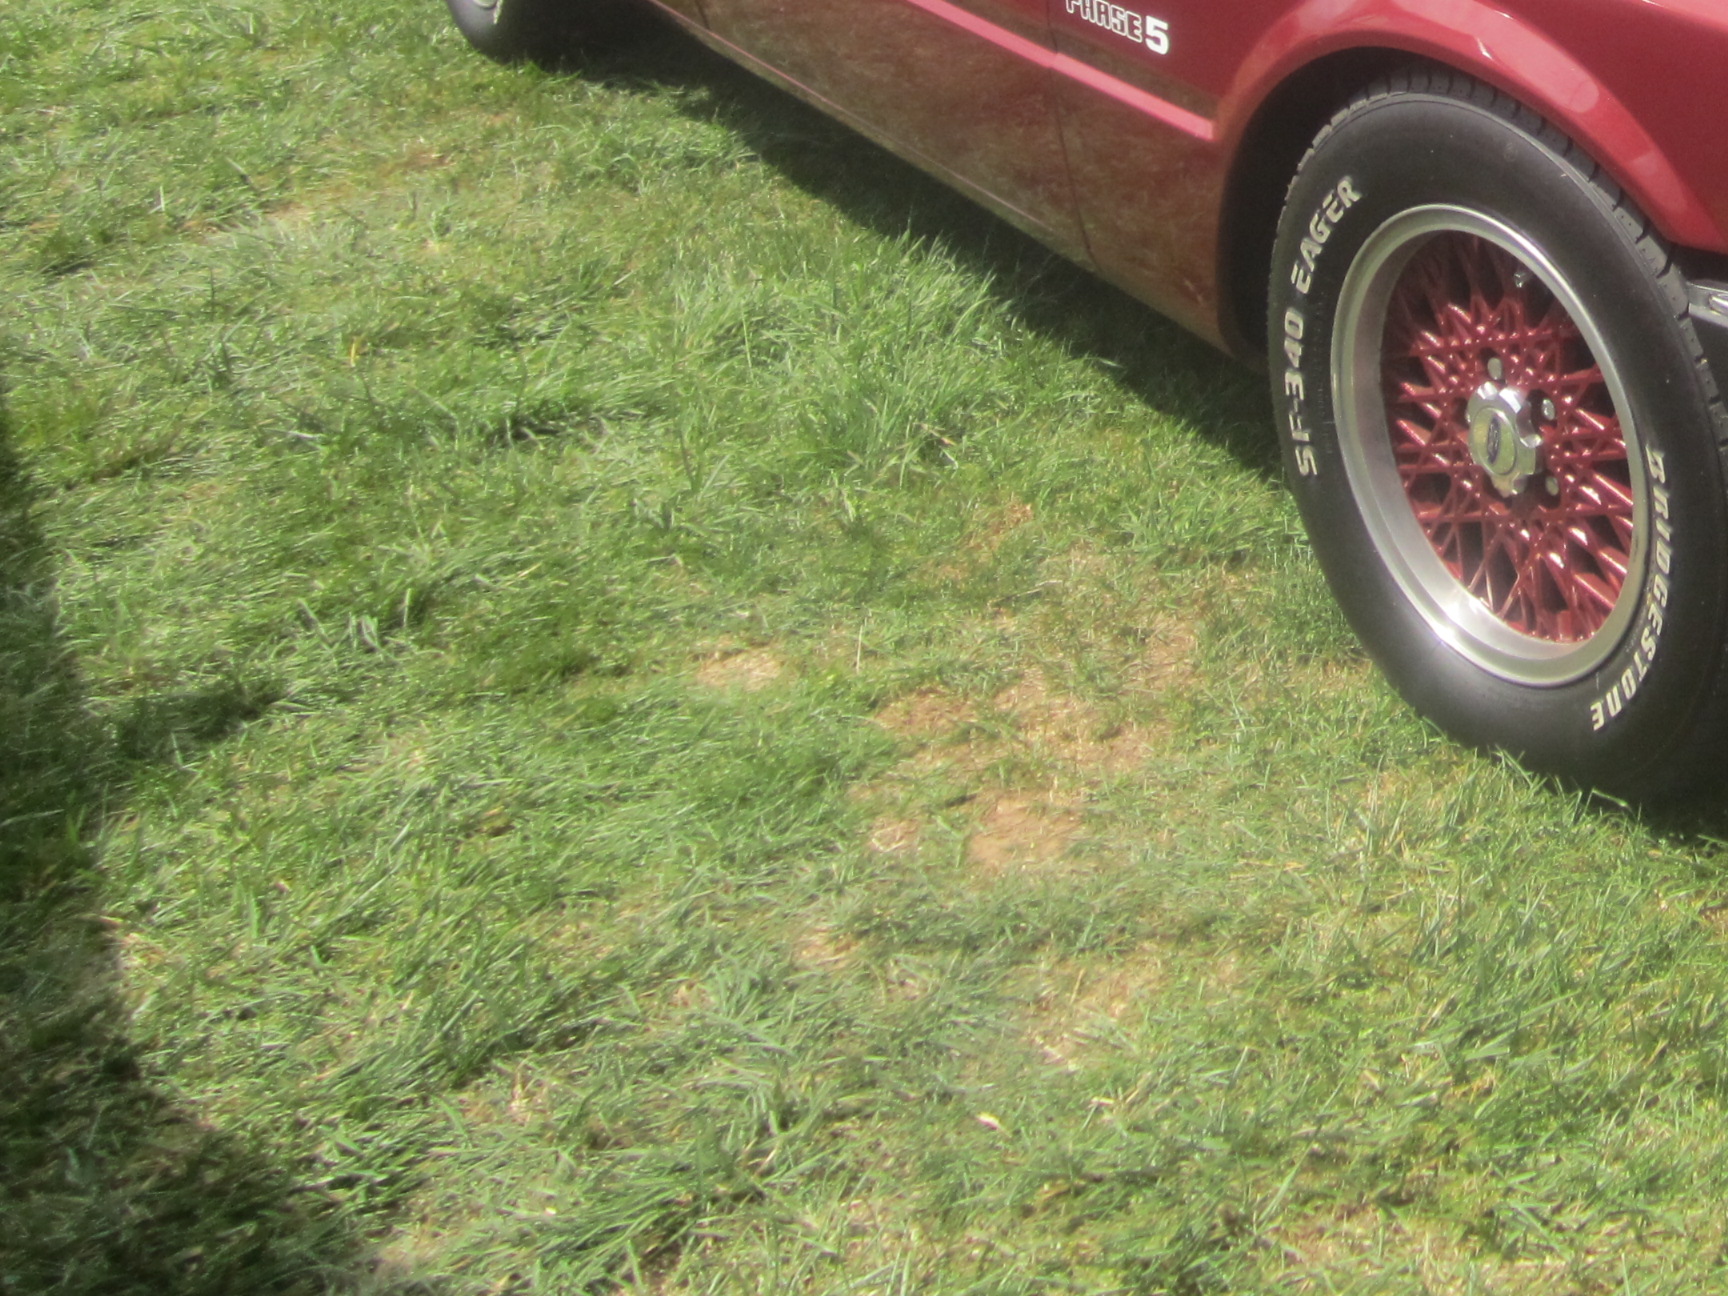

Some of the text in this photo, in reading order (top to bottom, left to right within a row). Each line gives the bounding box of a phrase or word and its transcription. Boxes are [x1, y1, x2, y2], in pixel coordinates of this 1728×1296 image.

[1145, 15, 1169, 55] 5
[1290, 175, 1362, 294] EAGER
[1284, 306, 1318, 477] SF-340
